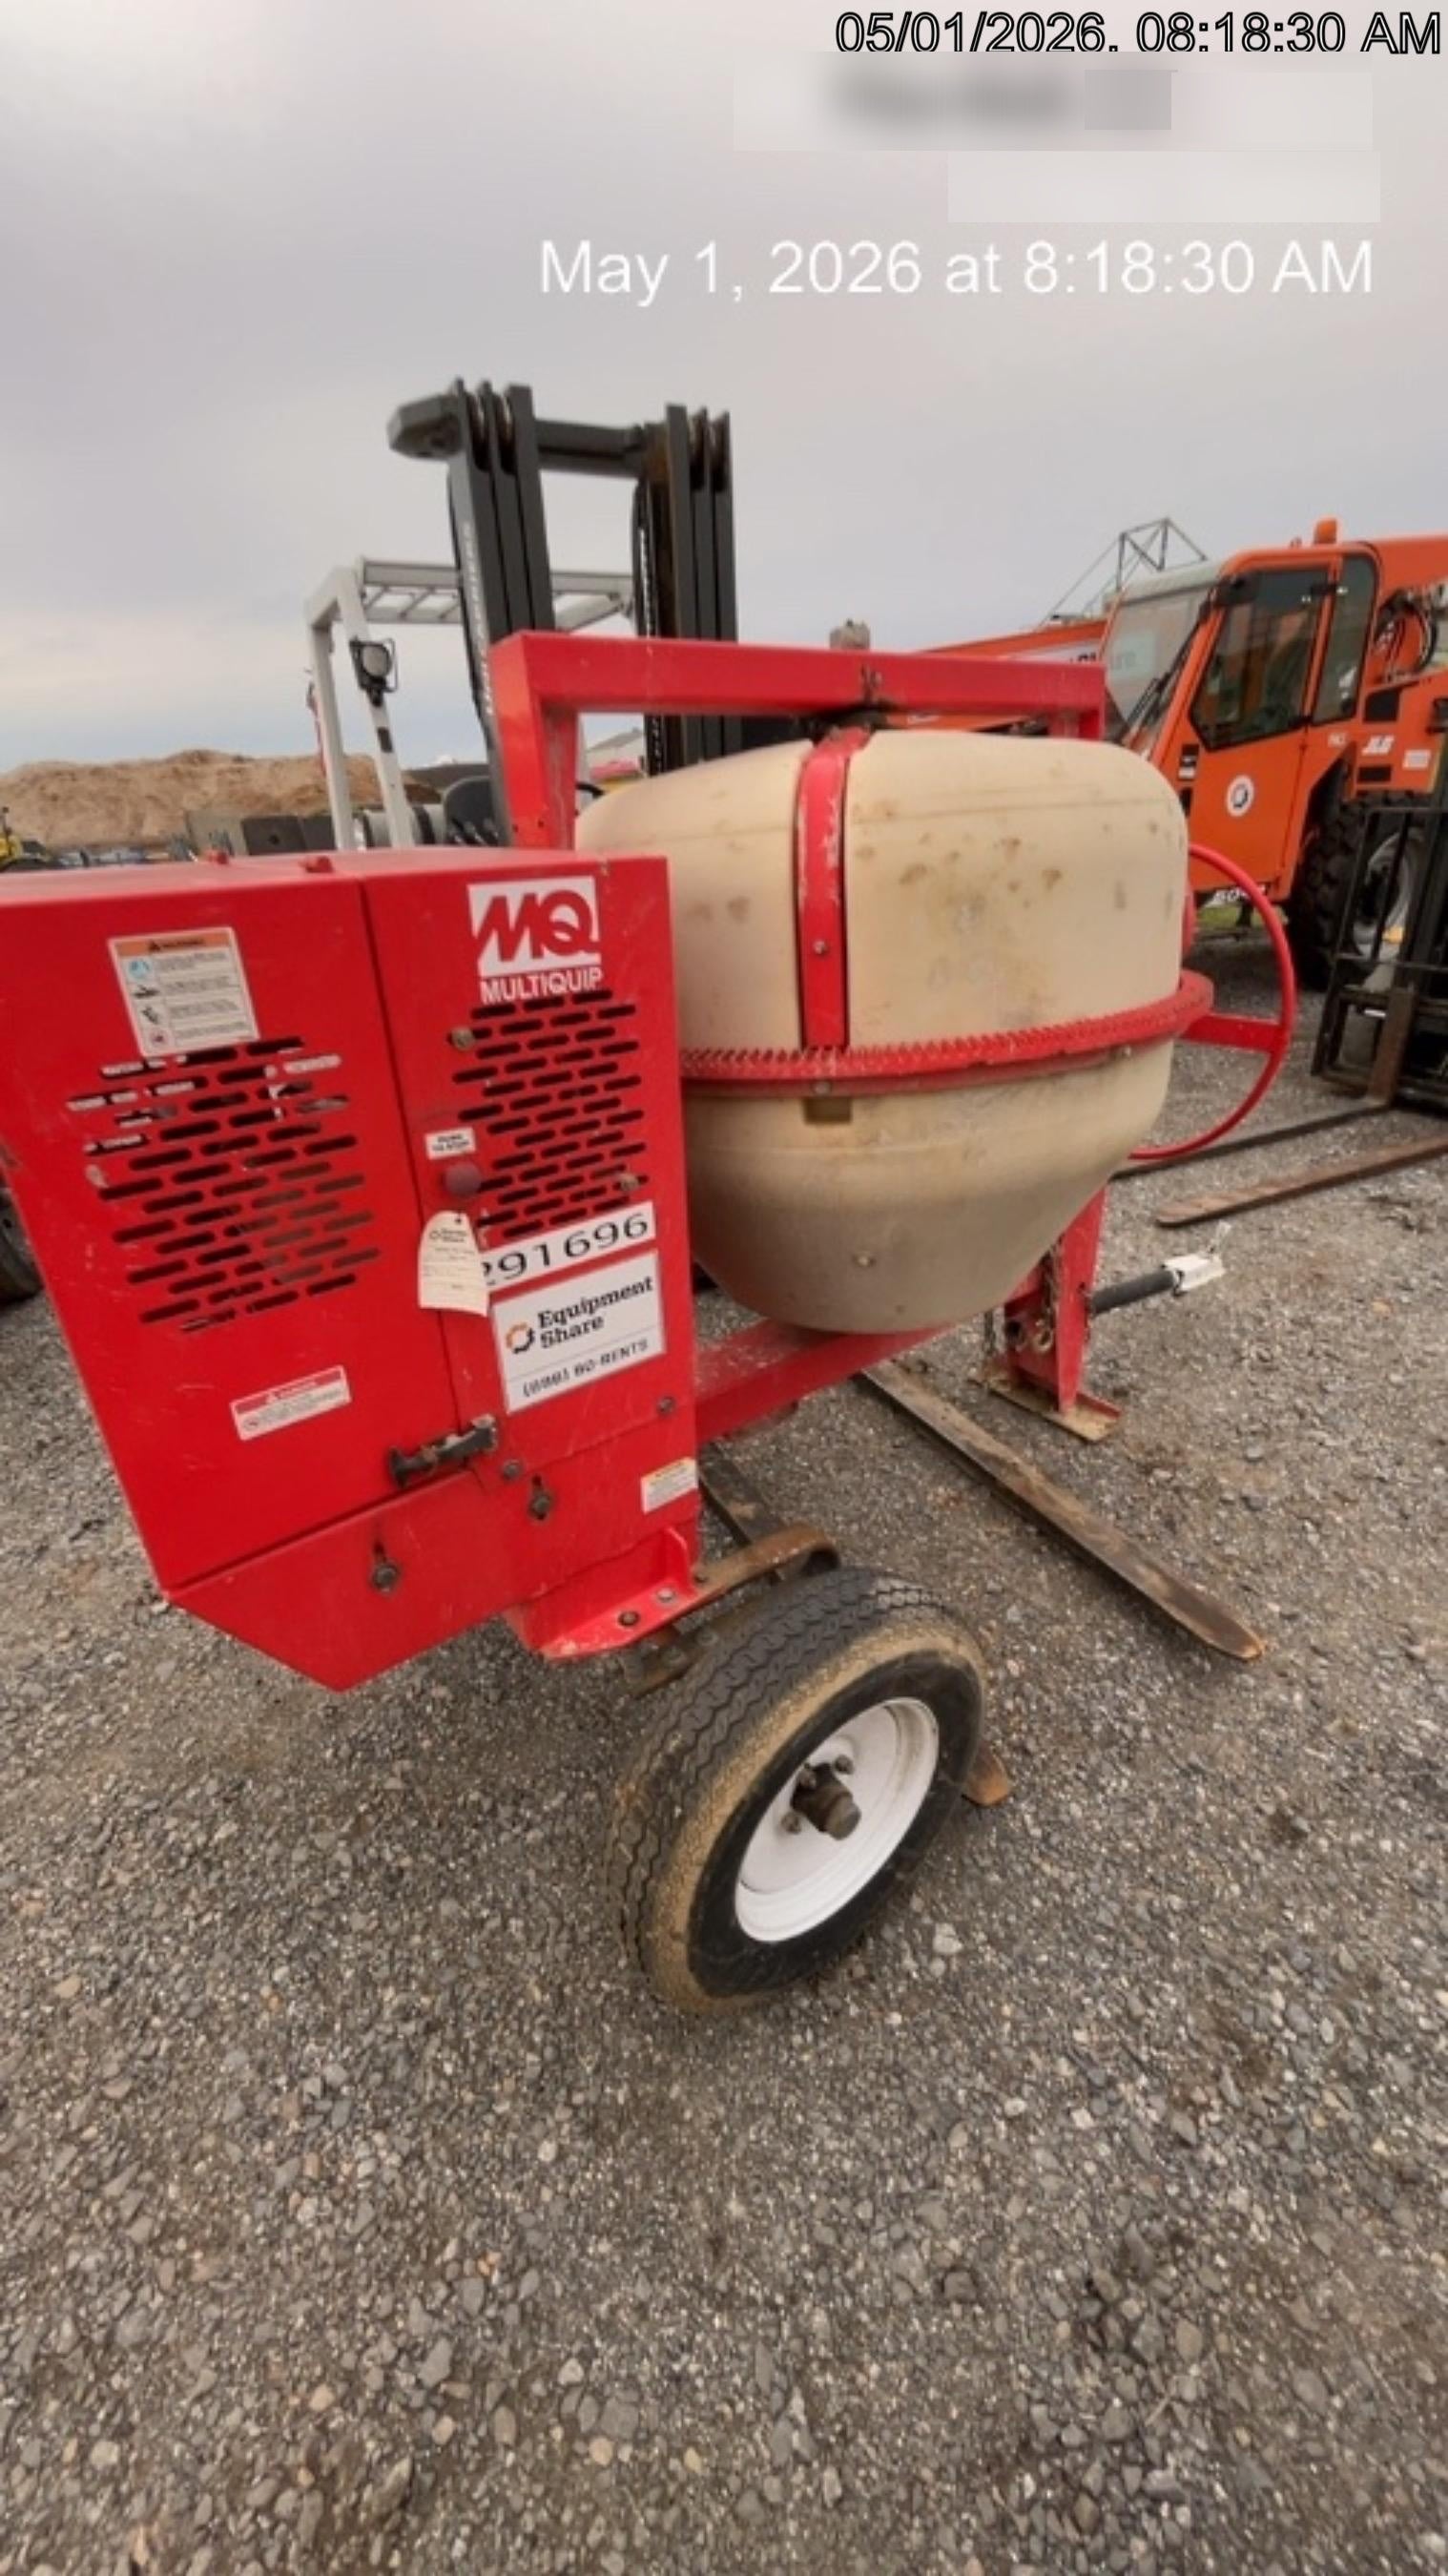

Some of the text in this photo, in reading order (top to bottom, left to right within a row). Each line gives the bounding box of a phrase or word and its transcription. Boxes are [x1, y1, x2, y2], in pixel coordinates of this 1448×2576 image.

[473, 888, 600, 964] MQ
[480, 966, 603, 1006] MULTIQUIP
[538, 1276, 653, 1329] Equipment
[540, 1316, 605, 1349] Share
